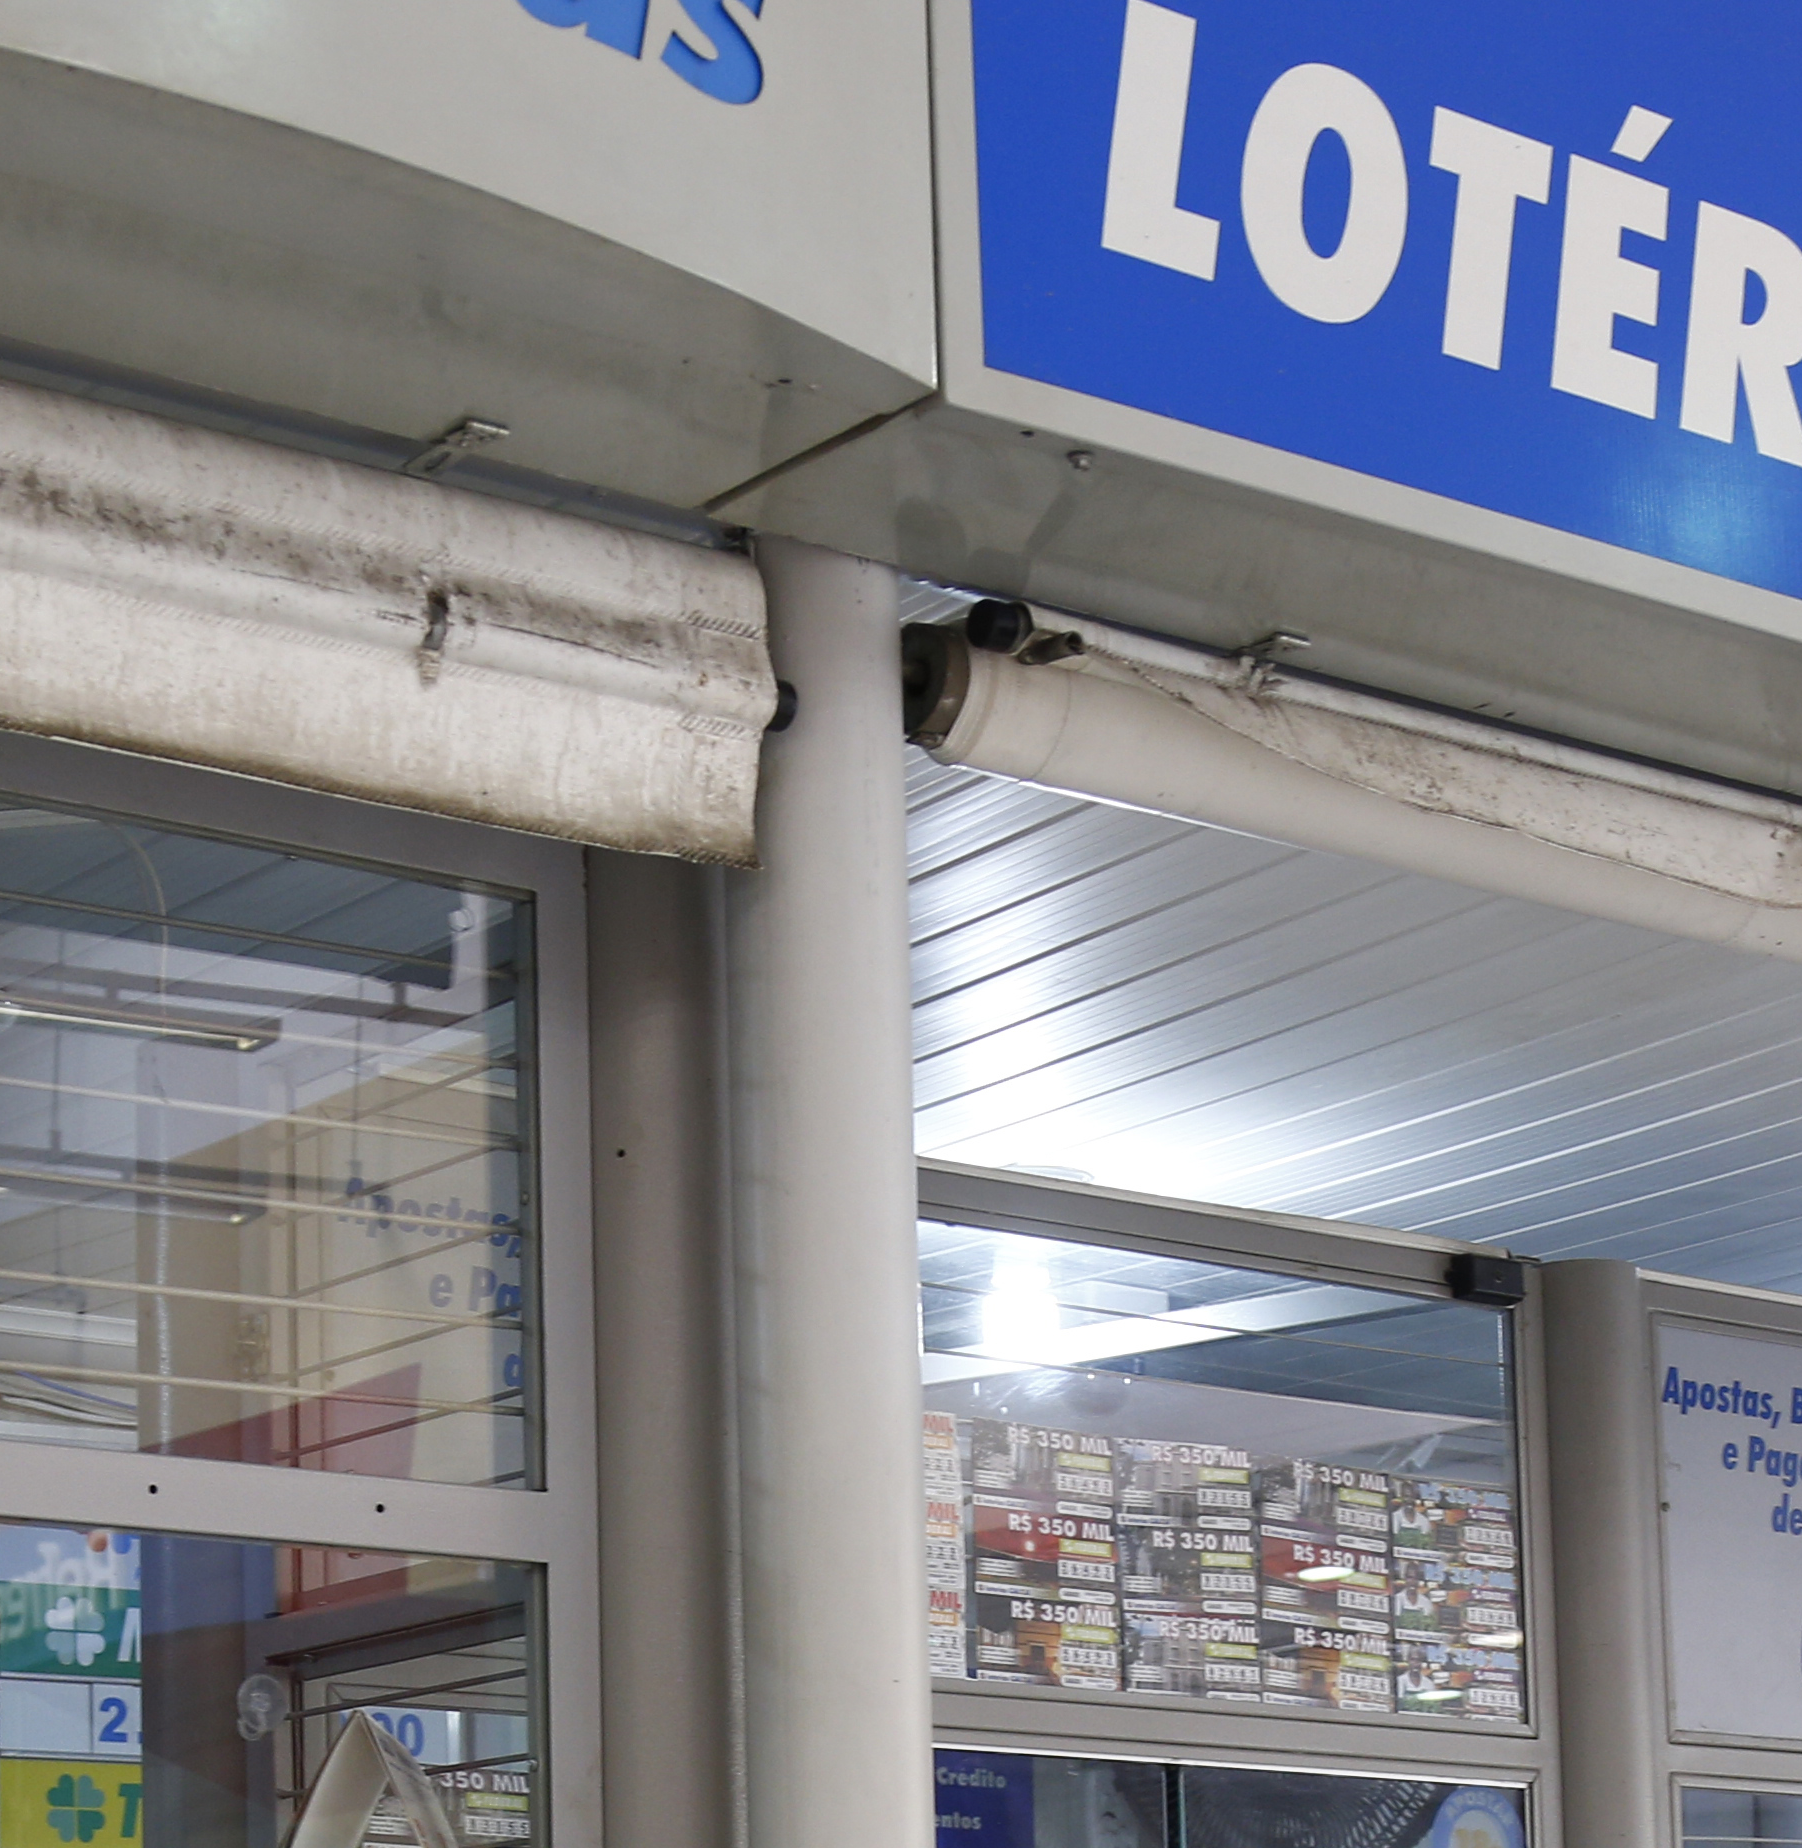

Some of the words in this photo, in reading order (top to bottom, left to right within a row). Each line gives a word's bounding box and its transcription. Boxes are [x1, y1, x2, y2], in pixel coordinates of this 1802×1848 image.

[1661, 1367, 1781, 1428] Apostas,
[1008, 1423, 1029, 1445] R$
[1037, 1430, 1072, 1449] 350
[1080, 1437, 1111, 1455] MIL
[1723, 1442, 1736, 1470] e
[1008, 1512, 1031, 1535] R$
[1039, 1517, 1076, 1537] 350
[1082, 1523, 1114, 1541] MIL
[1153, 1530, 1174, 1549] R$
[1181, 1532, 1217, 1549] 350
[1223, 1536, 1254, 1552] MIL
[1293, 1544, 1314, 1563] R$
[1320, 1550, 1354, 1567] 350
[1360, 1555, 1389, 1573] MIL
[1011, 1601, 1034, 1622] R$
[1041, 1605, 1078, 1623] 350
[1085, 1610, 1116, 1627] MIL
[441, 1771, 485, 1790] 350
[493, 1773, 530, 1793] MIL
[935, 1767, 1007, 1790] Crédito
